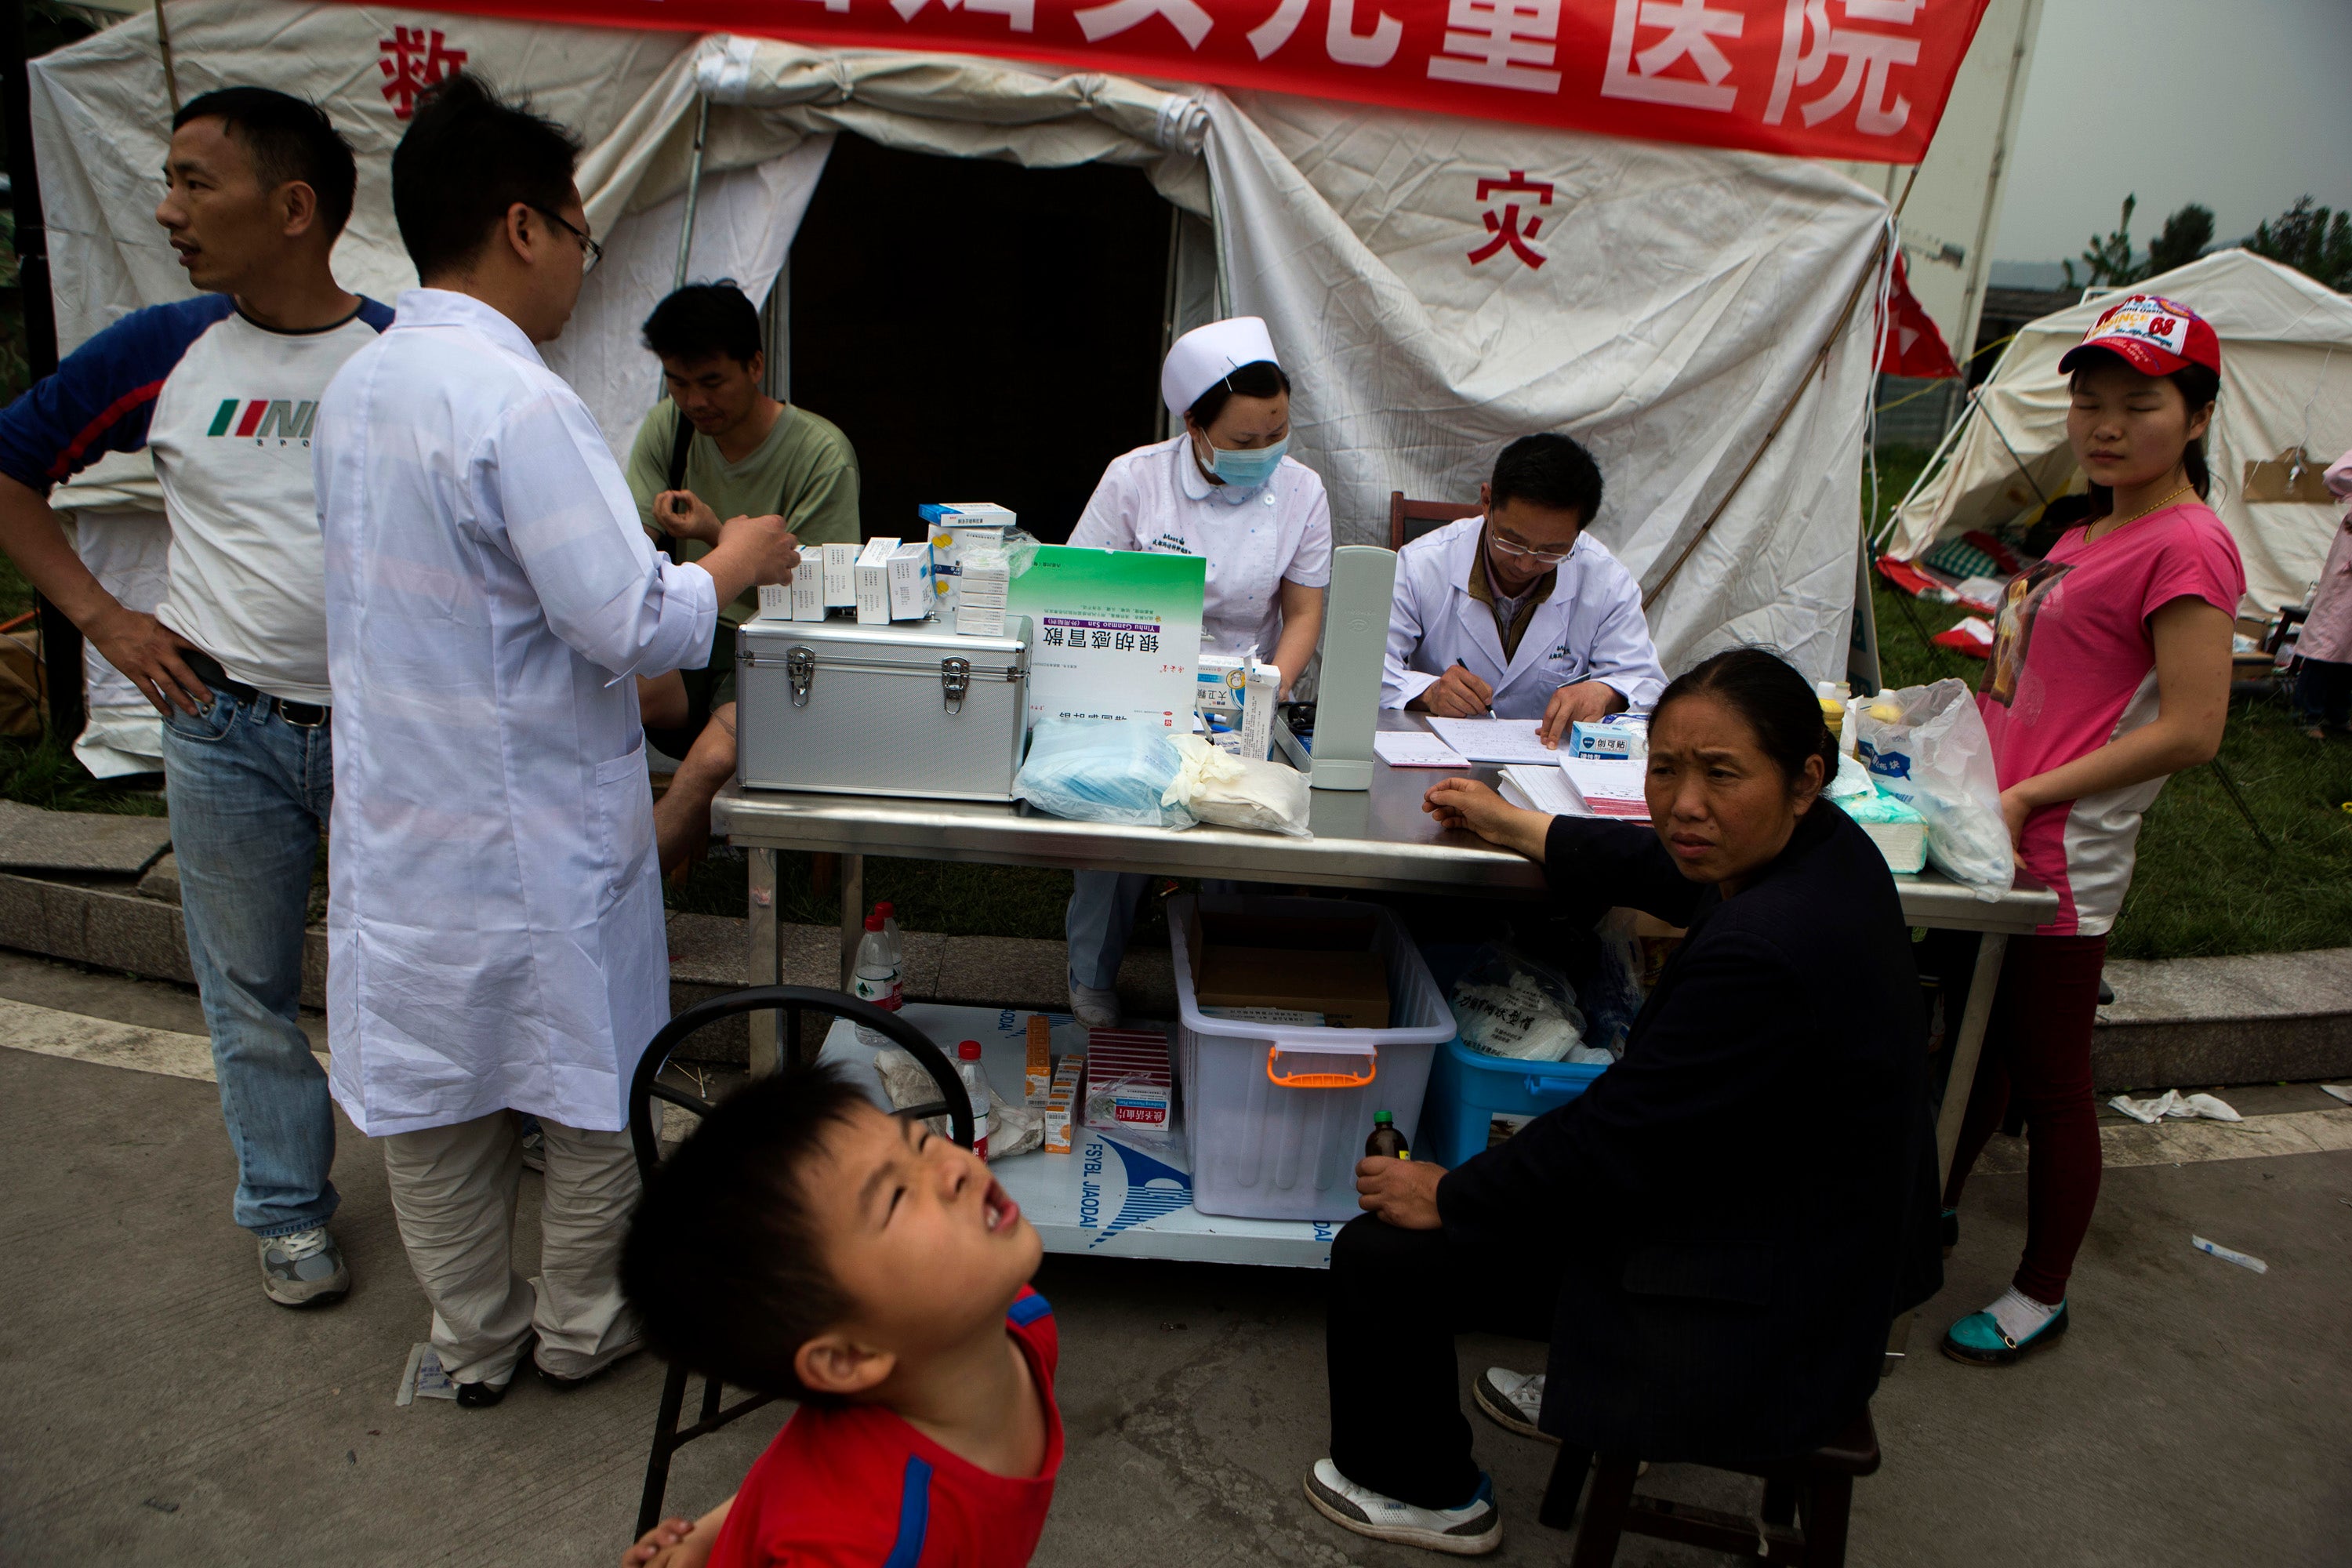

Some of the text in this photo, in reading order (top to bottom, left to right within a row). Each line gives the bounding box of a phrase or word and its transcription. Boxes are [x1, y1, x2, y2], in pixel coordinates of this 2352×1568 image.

[378, 25, 468, 120] 救
[1467, 169, 1554, 270] 灾
[256, 439, 310, 448] SPO
[1103, 622, 1132, 630] Ganmao
[1134, 624, 1155, 633] Yinhu
[1043, 627, 1160, 654] 银胡感冒散
[1597, 739, 1626, 750] 创可贴
[1116, 1108, 1163, 1122] 独圣活血片
[1083, 1142, 1103, 1178] FSYBL
[1079, 1181, 1101, 1229] JIAODAI
[1312, 1220, 1333, 1243] DAI
